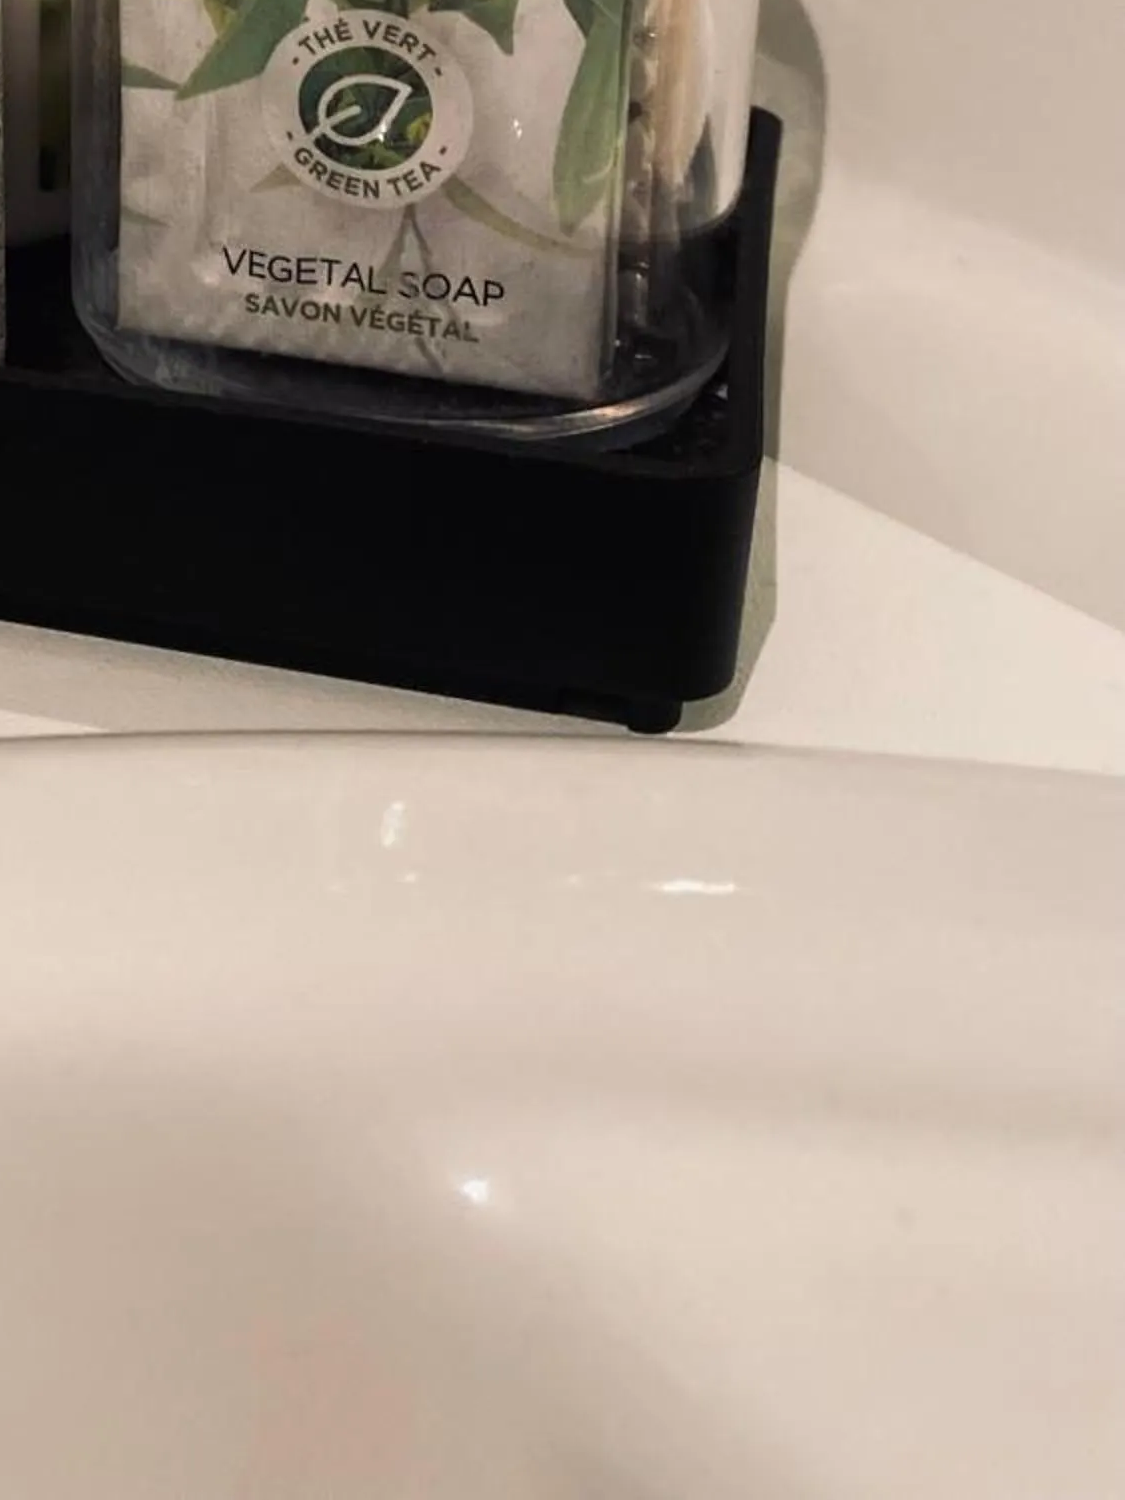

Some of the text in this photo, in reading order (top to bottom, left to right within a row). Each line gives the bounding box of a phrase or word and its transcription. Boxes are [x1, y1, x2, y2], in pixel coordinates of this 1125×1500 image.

[298, 18, 436, 61] THÉ VERT
[294, 147, 442, 199] GREEN TEA
[222, 247, 506, 307] VEGETAL SOAP
[245, 293, 480, 344] SAVON VÉGÉTAL
